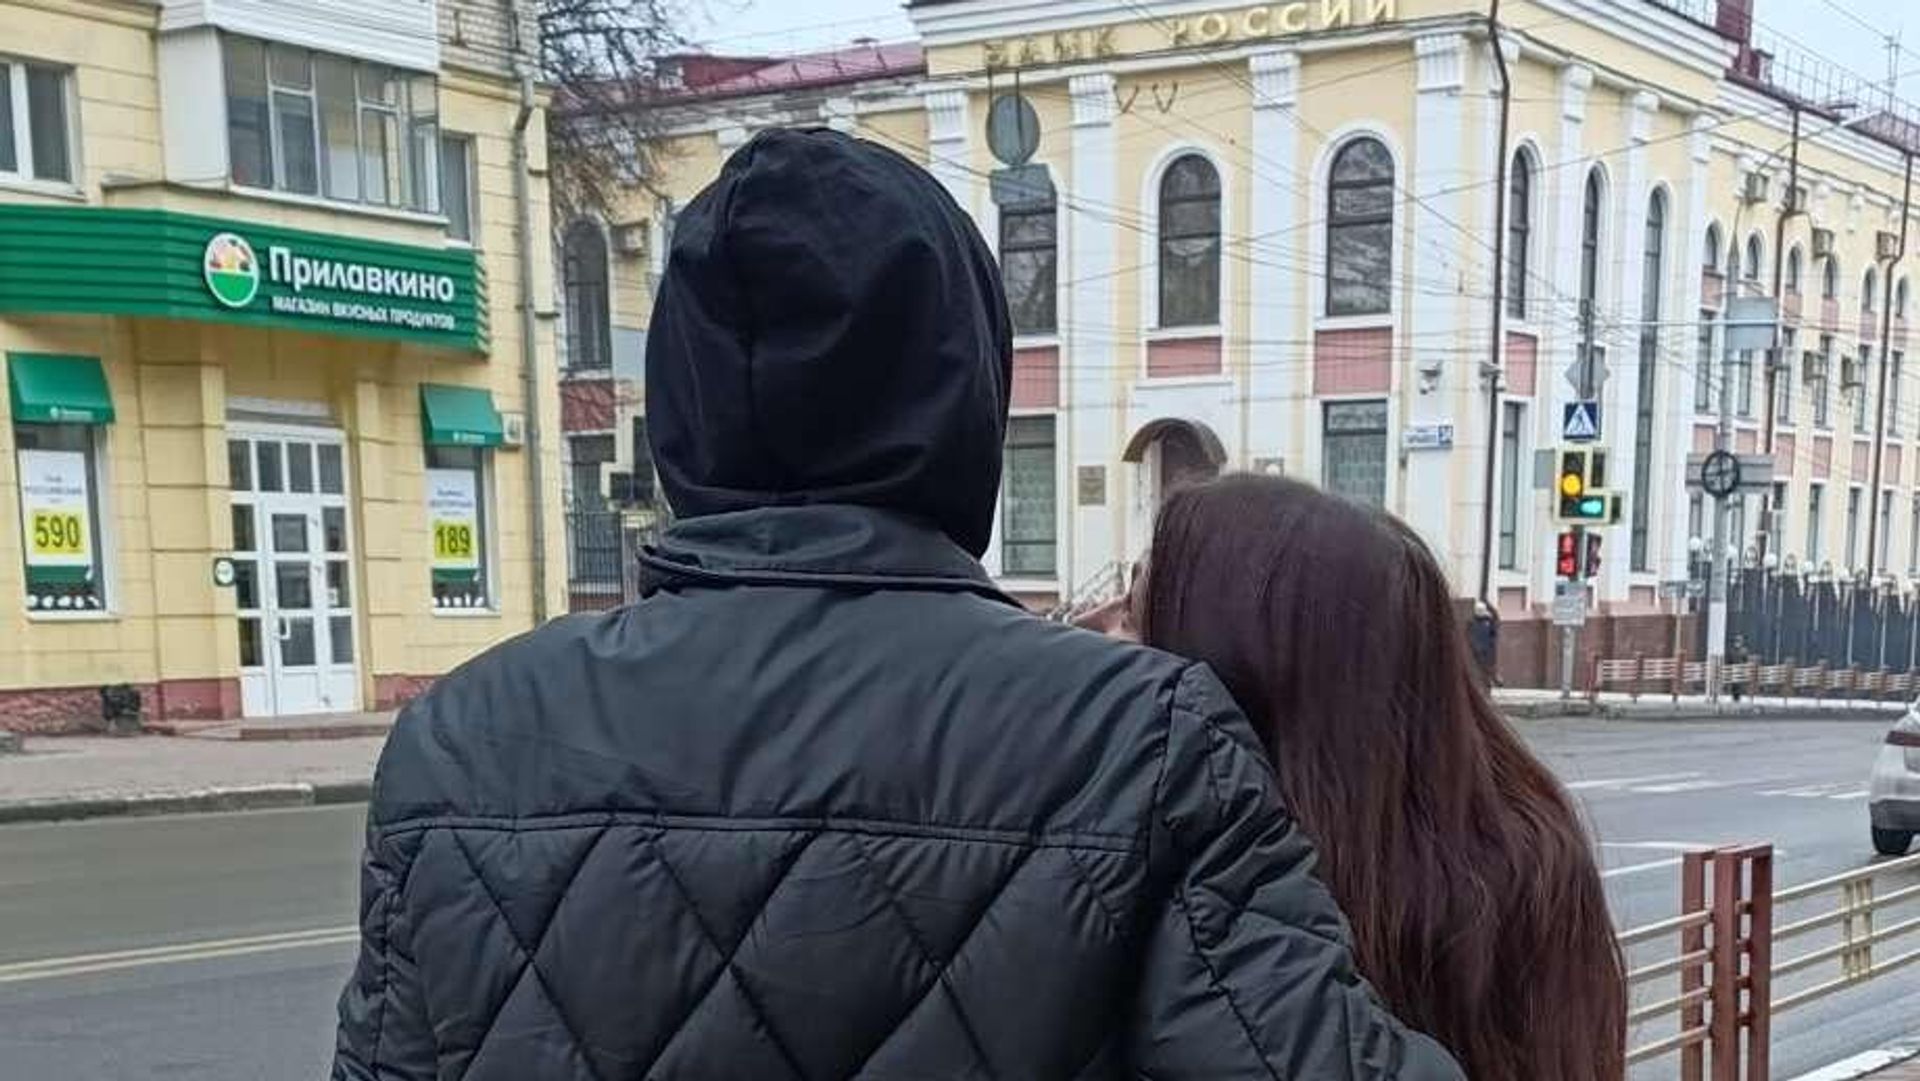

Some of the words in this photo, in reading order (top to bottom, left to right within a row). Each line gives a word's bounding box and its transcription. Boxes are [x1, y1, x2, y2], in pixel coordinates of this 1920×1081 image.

[1167, 0, 1398, 46] РОССИИ
[269, 246, 455, 301] Прилавкино
[273, 297, 330, 316] МАГАЗИН
[332, 301, 388, 322] ВКУСНЫХ
[390, 306, 455, 331] ПРОДУКТОВ
[35, 515, 80, 548] 590
[436, 525, 471, 554] 189
